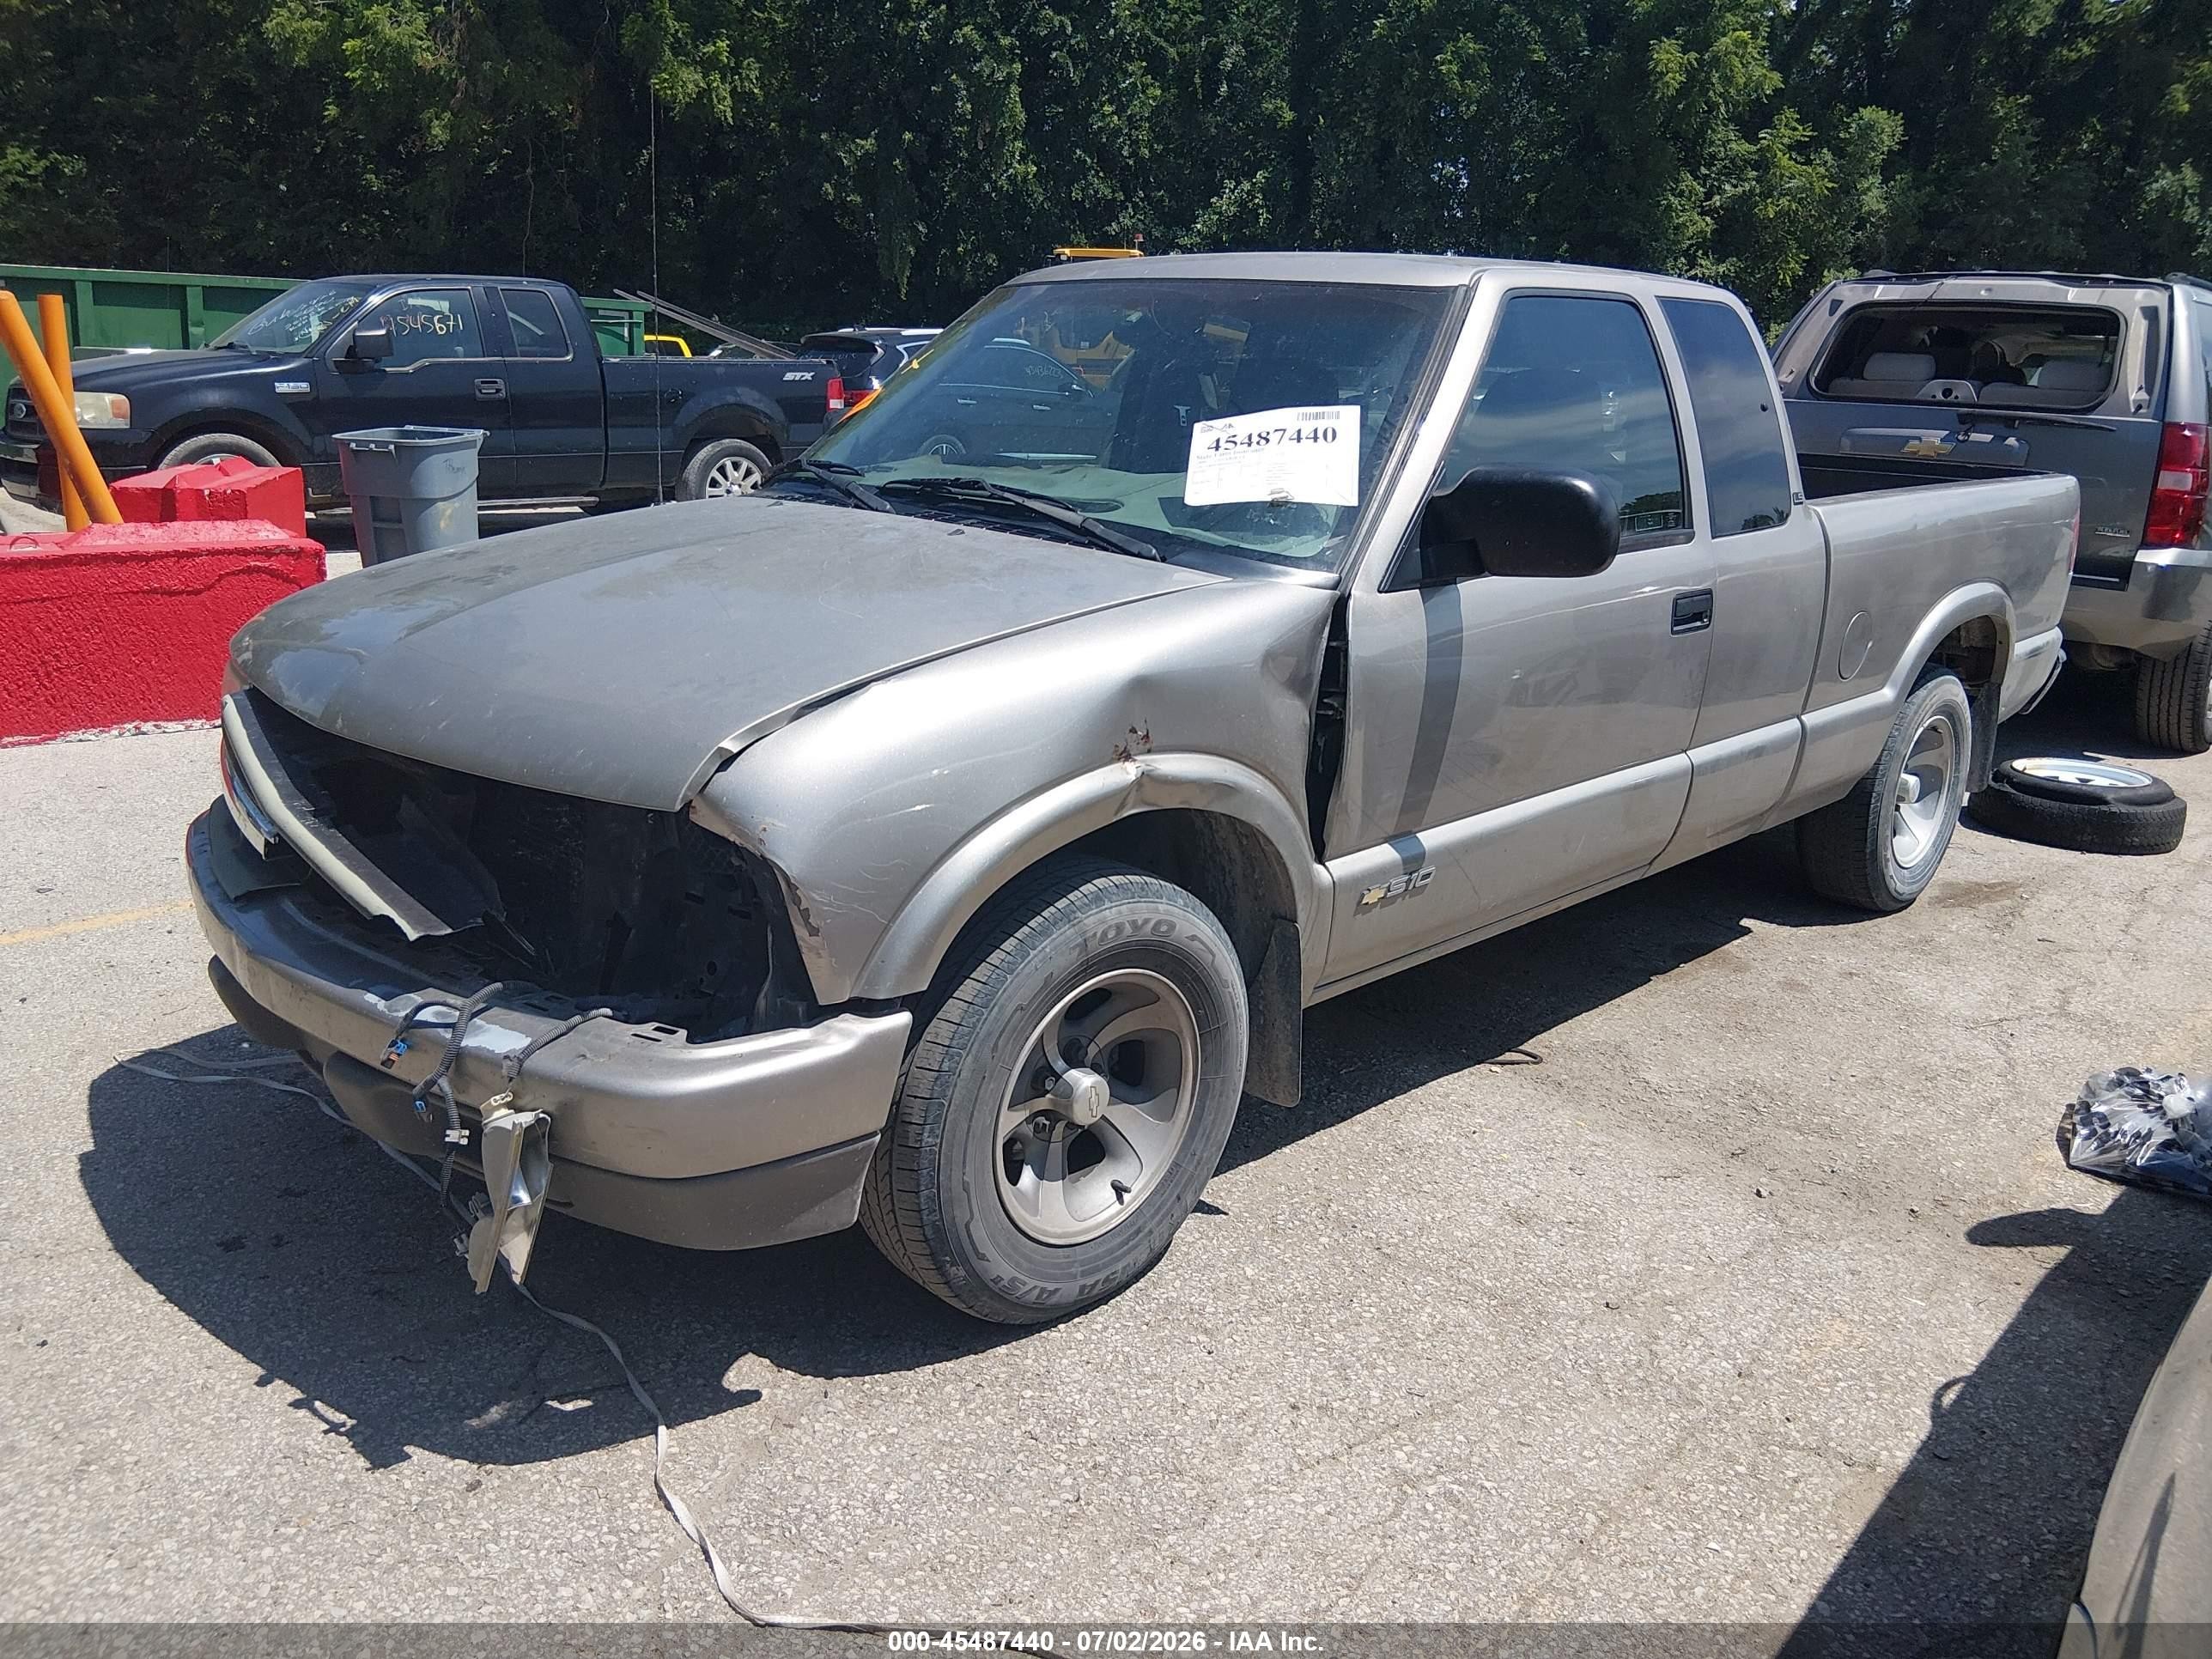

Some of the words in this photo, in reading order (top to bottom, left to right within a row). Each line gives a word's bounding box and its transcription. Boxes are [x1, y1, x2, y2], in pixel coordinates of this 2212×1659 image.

[782, 372, 816, 380] STX
[1206, 426, 1337, 452] 45487440
[1386, 866, 1437, 898] S10
[1069, 917, 1178, 960] TOYO
